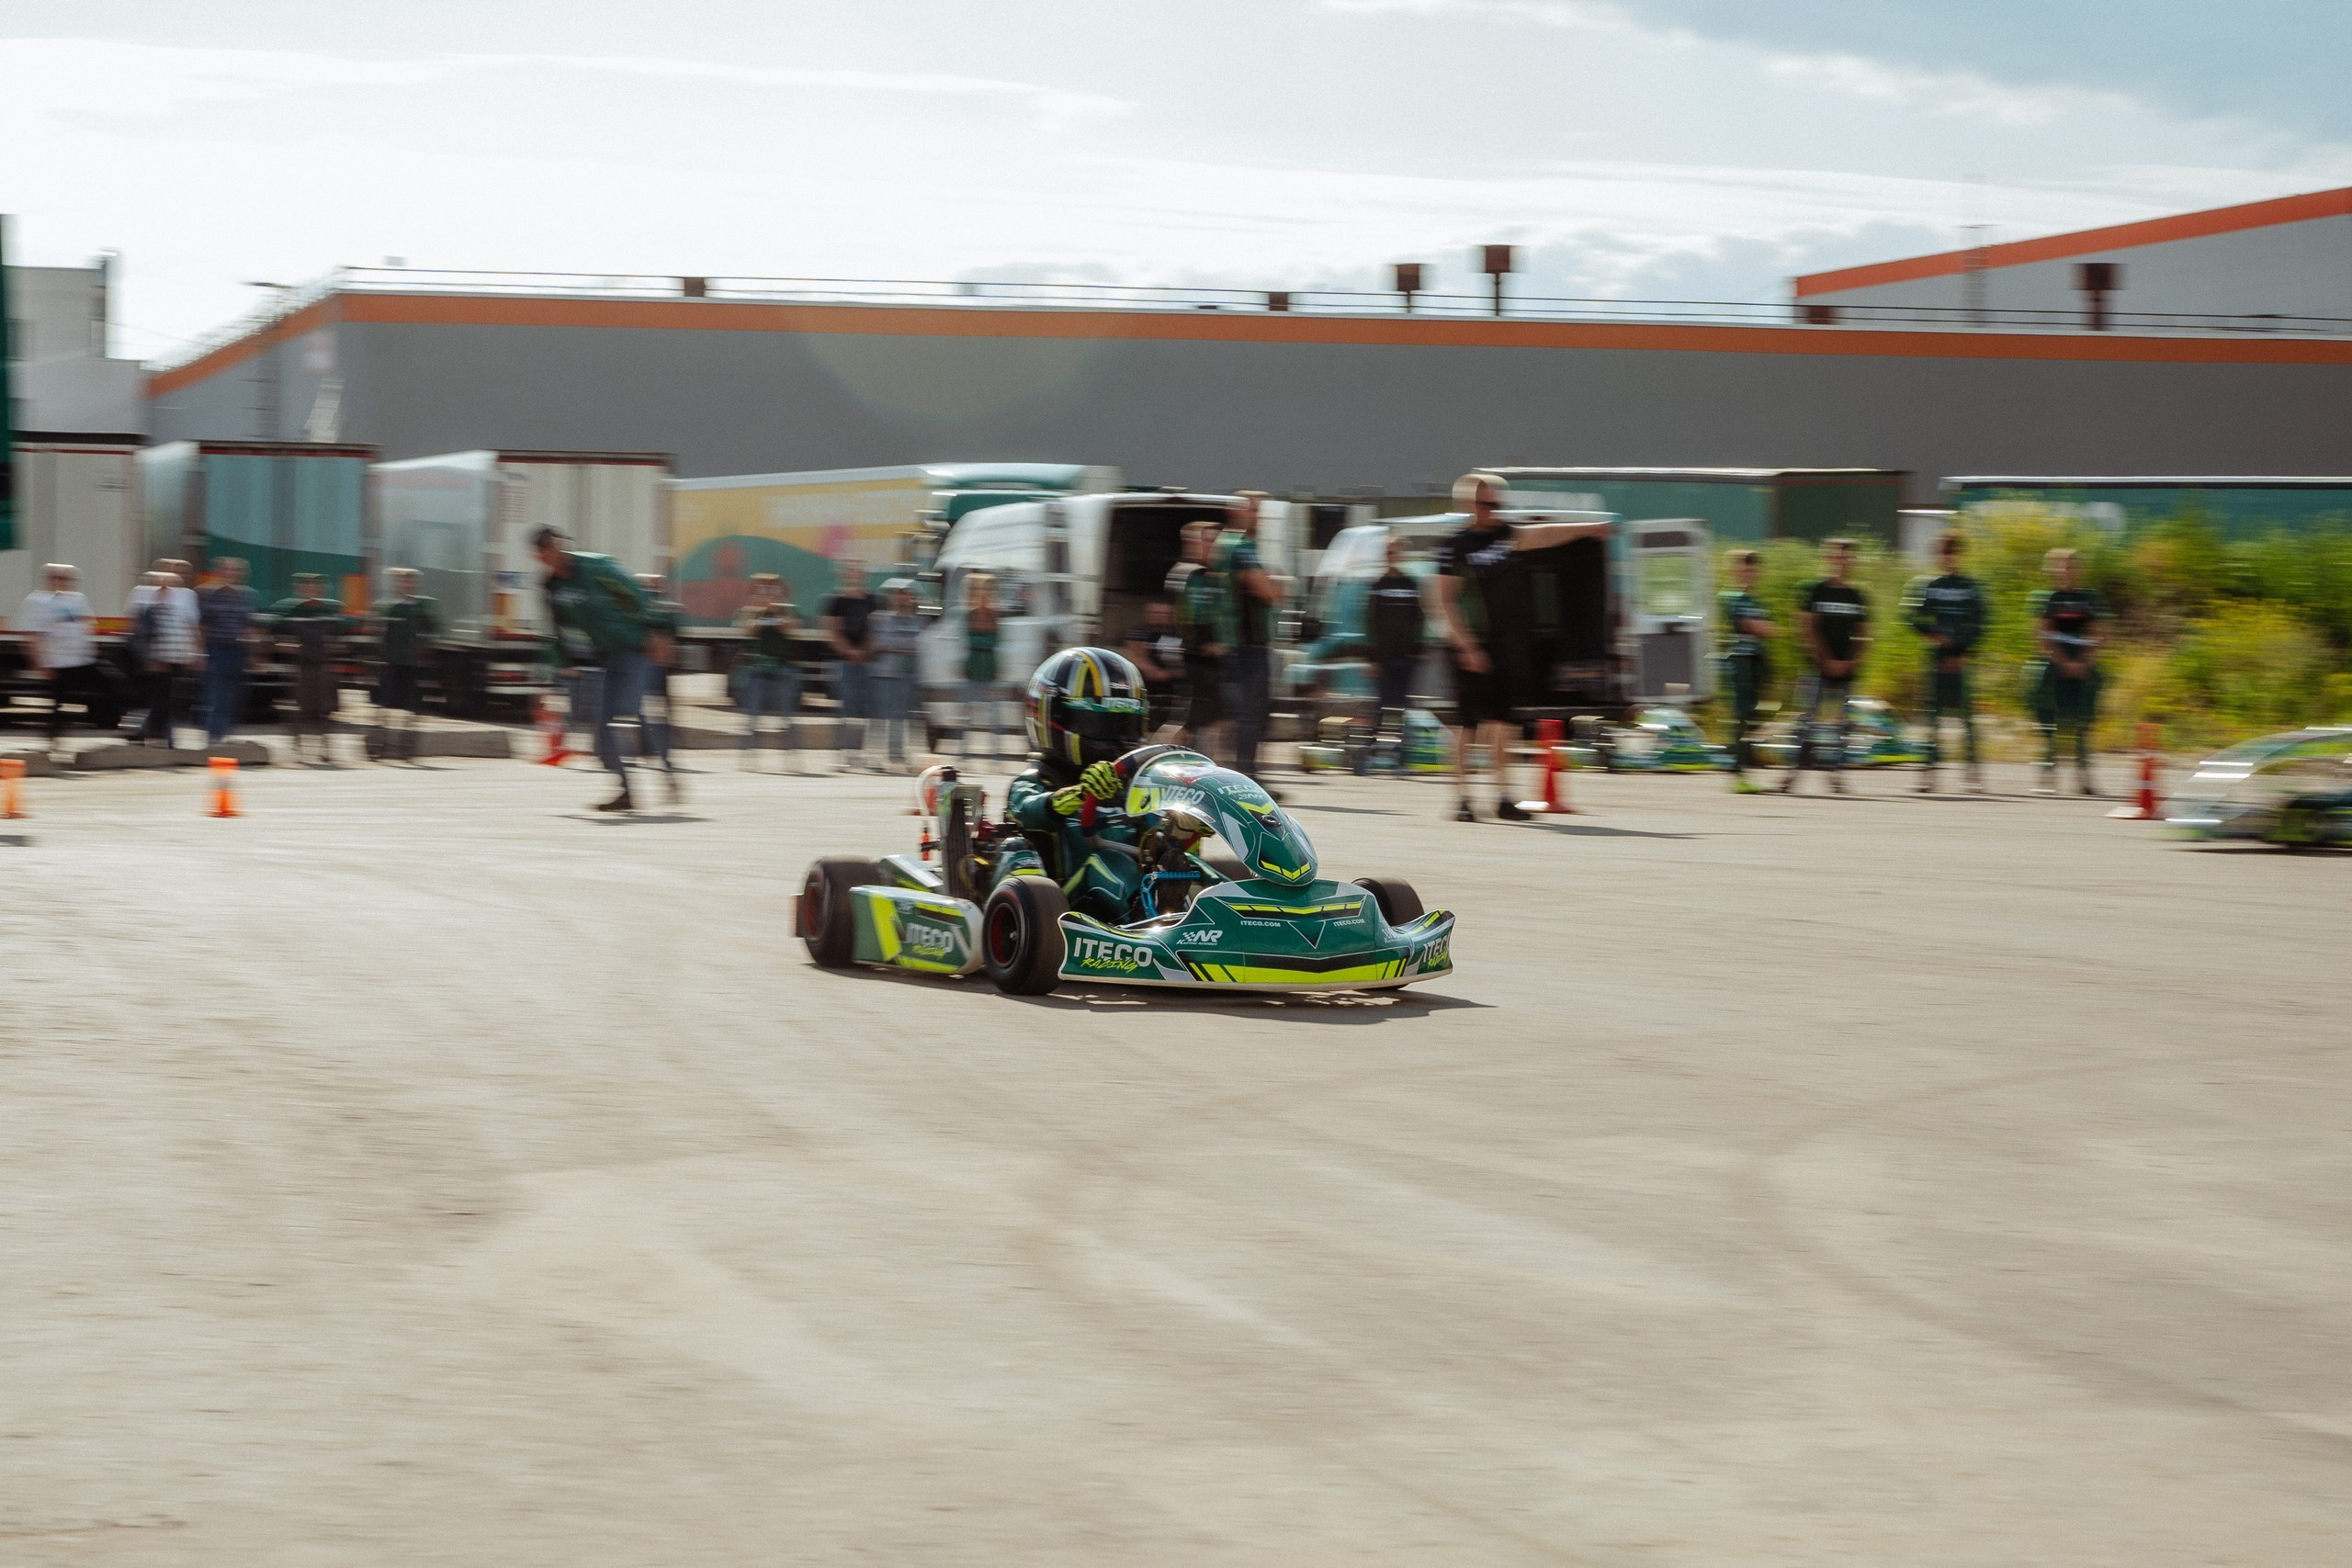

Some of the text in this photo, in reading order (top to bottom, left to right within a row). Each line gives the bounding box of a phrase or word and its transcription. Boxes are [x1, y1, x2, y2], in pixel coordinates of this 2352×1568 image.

[1240, 919, 1281, 928] ITECO.COM
[1332, 919, 1366, 927] ITECO.COM
[906, 922, 955, 953] ITECO
[1193, 930, 1223, 942] NR
[1074, 937, 1153, 967] ITECO
[1081, 955, 1139, 974] RACING
